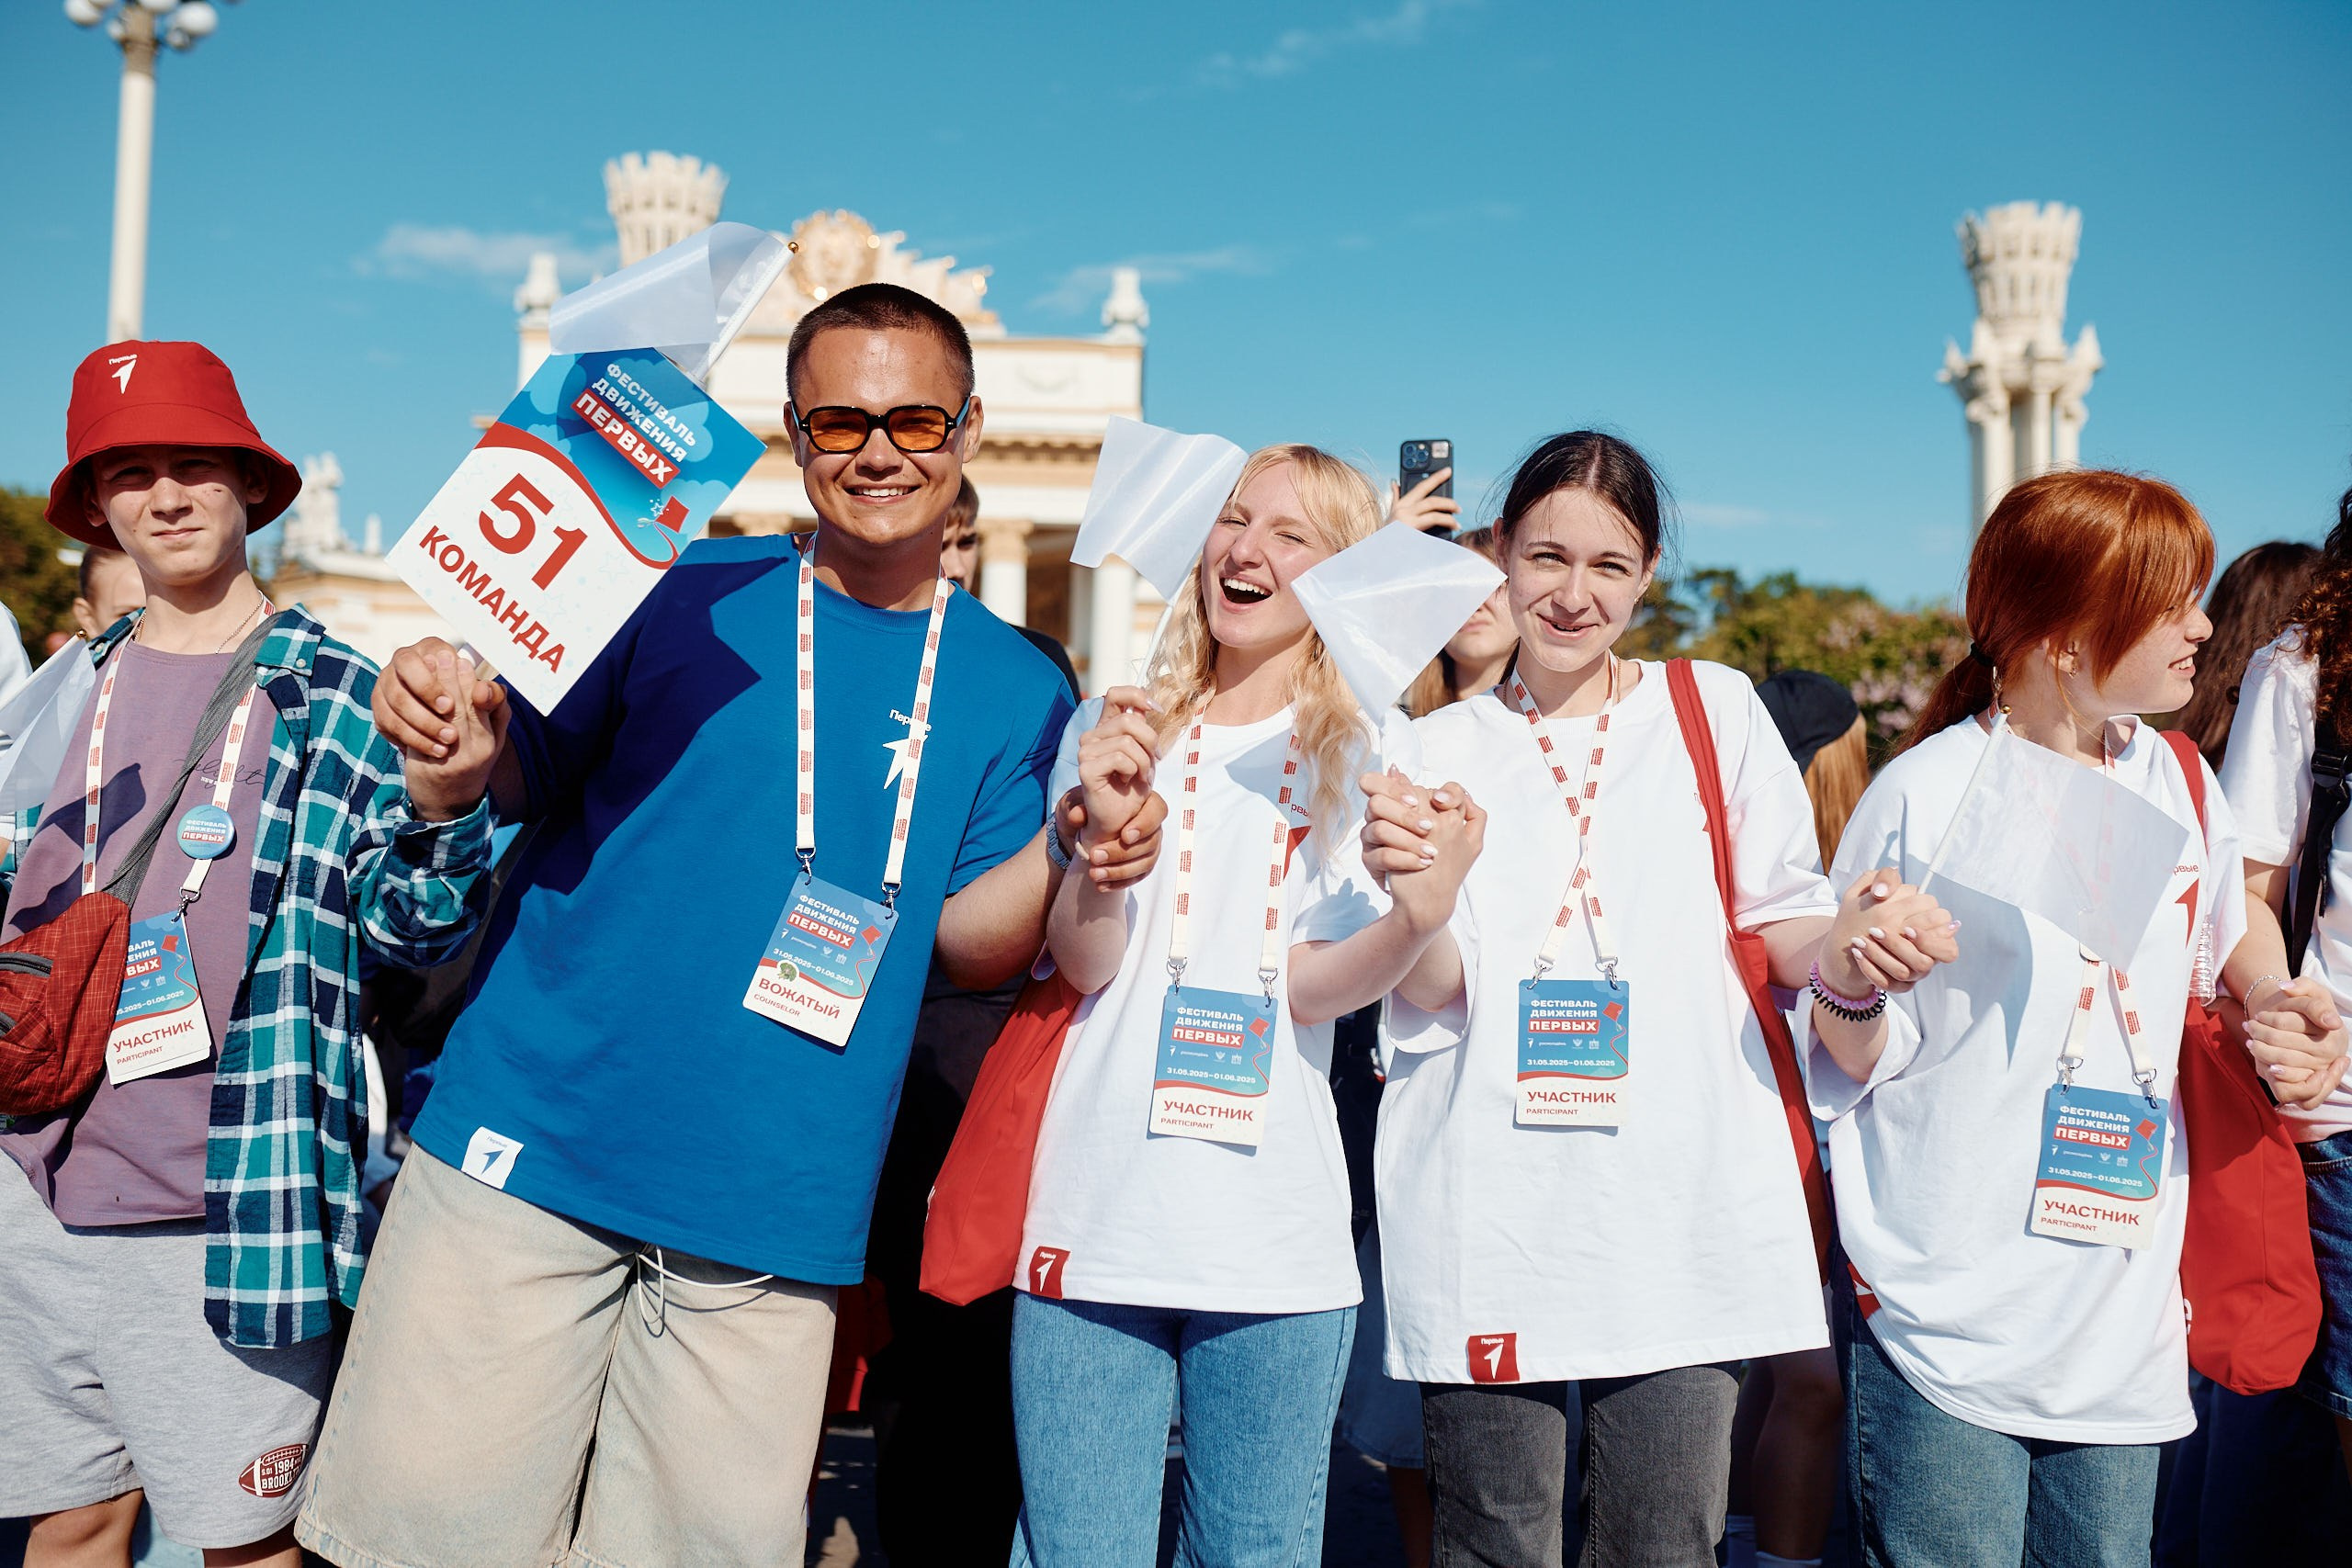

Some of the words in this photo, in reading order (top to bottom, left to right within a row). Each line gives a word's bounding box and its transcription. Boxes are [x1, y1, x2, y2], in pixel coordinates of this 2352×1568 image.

[606, 363, 696, 447] ФЕСТИВАЛЬ
[592, 378, 688, 463] ДВИЖЕНИЯ
[576, 392, 673, 483] ПЕРВЫХ
[479, 473, 588, 591] 51
[419, 525, 566, 674] КОМАНДА
[889, 708, 932, 732] Пере
[186, 819, 227, 828] ФЕСТИВАЛЬ
[182, 831, 225, 842] ПЕРВЫХ
[2173, 864, 2199, 876] рвые
[795, 903, 857, 935] ДВИЖЕНИЯ
[799, 894, 860, 926] ФЕСТИВАЛЬ
[788, 913, 853, 947] ПЕРВЫХ
[127, 947, 157, 963] ЕНИЯ
[126, 958, 160, 976] ВЫХ
[753, 993, 801, 1017] COUNSELOR
[759, 977, 841, 1020] ВОЖАТЫЙ
[1531, 999, 1598, 1008] ФЕСТИВАЛЬ
[1177, 1006, 1244, 1021] ФЕСТИВАЛЬ
[1530, 1010, 1598, 1019] ДВИЖЕНИЯ
[1175, 1017, 1243, 1032] ДВИЖЕНИЯ
[1530, 1021, 1597, 1032] ПЕРВЫХ
[113, 1020, 195, 1053] УЧАСТНИК
[1172, 1027, 1242, 1045] ПЕРВЫХ
[117, 1045, 164, 1066] PARTICIPANT
[1527, 1091, 1617, 1103] УЧАСТНИК
[1163, 1100, 1254, 1122] УЧАСТНИК
[2059, 1105, 2132, 1123] ФЕСТИВАЛЬ
[1160, 1117, 1215, 1129] PARTICIPANT
[2057, 1115, 2130, 1134] ДВИЖЕНИЯ
[2055, 1126, 2129, 1147] ПЕРВЫХ
[2044, 1200, 2140, 1225] УЧАСТНИК
[2041, 1216, 2098, 1232] PARTICIPANT
[274, 1457, 295, 1475] 1984
